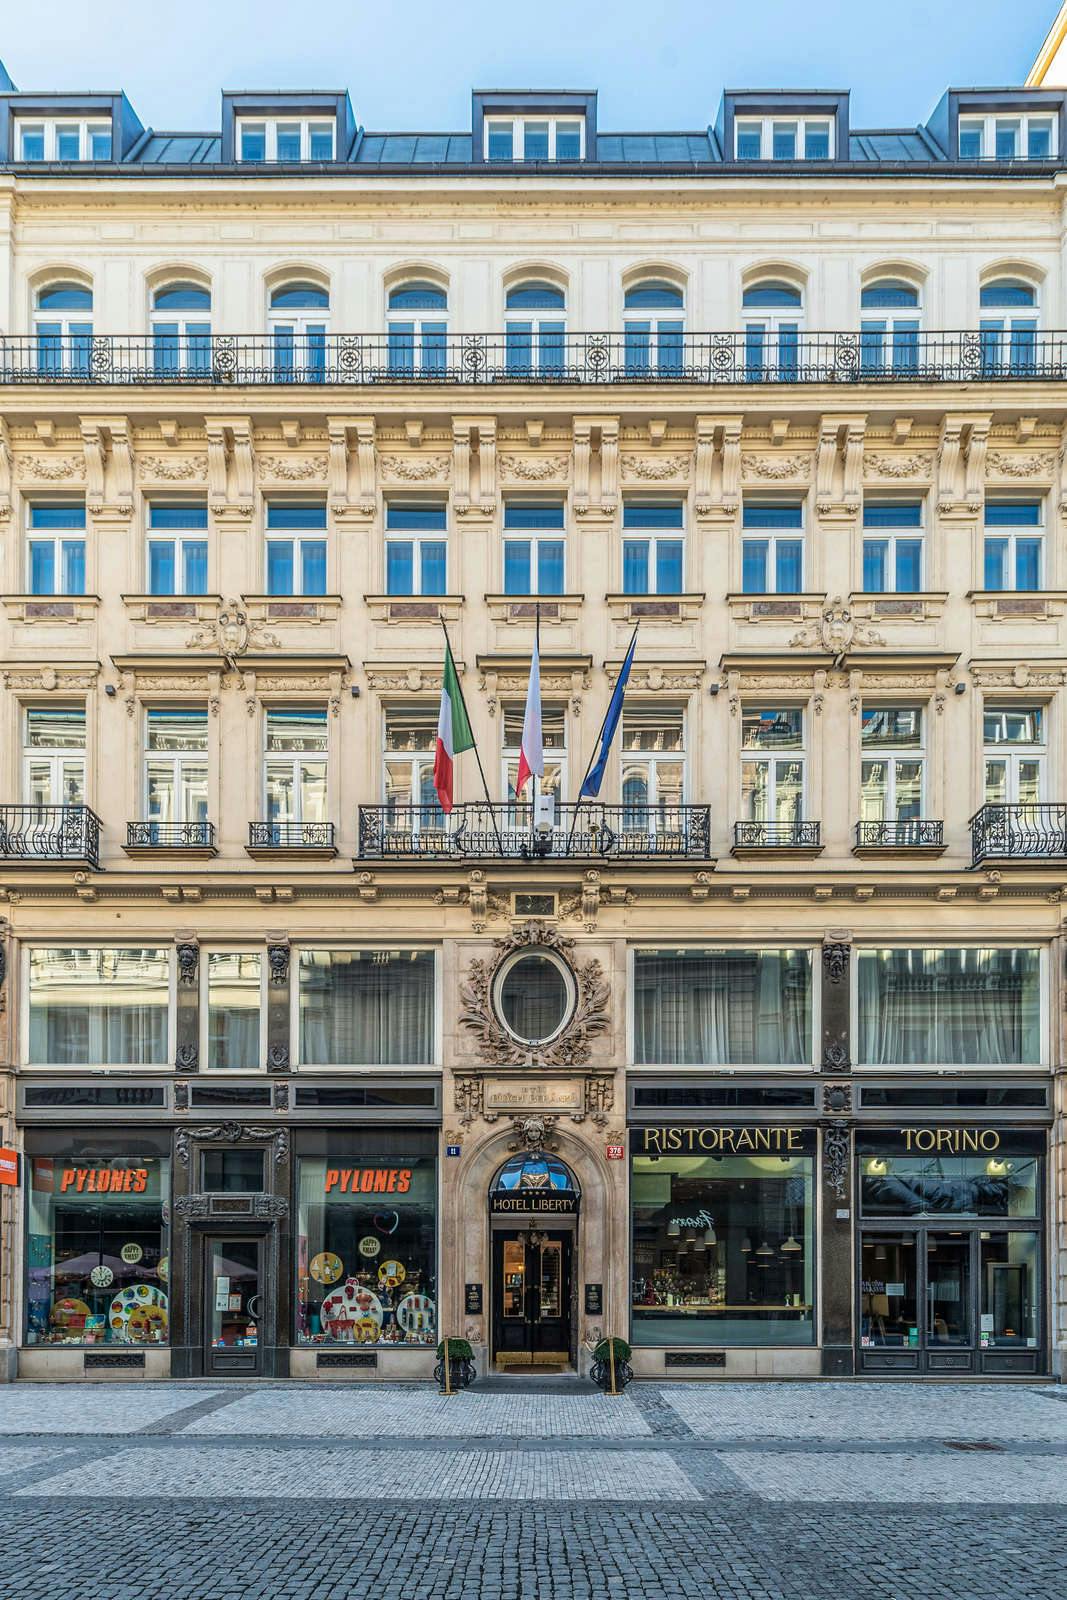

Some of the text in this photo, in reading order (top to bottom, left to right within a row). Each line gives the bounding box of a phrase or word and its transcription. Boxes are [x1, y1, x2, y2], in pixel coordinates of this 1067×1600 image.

[644, 1128, 804, 1153] RISTORANTE
[900, 1129, 1000, 1154] TORINO
[60, 1168, 148, 1192] PYLONES
[324, 1168, 412, 1192] PYLONES
[493, 1199, 575, 1212] HOTEL LIBERTY
